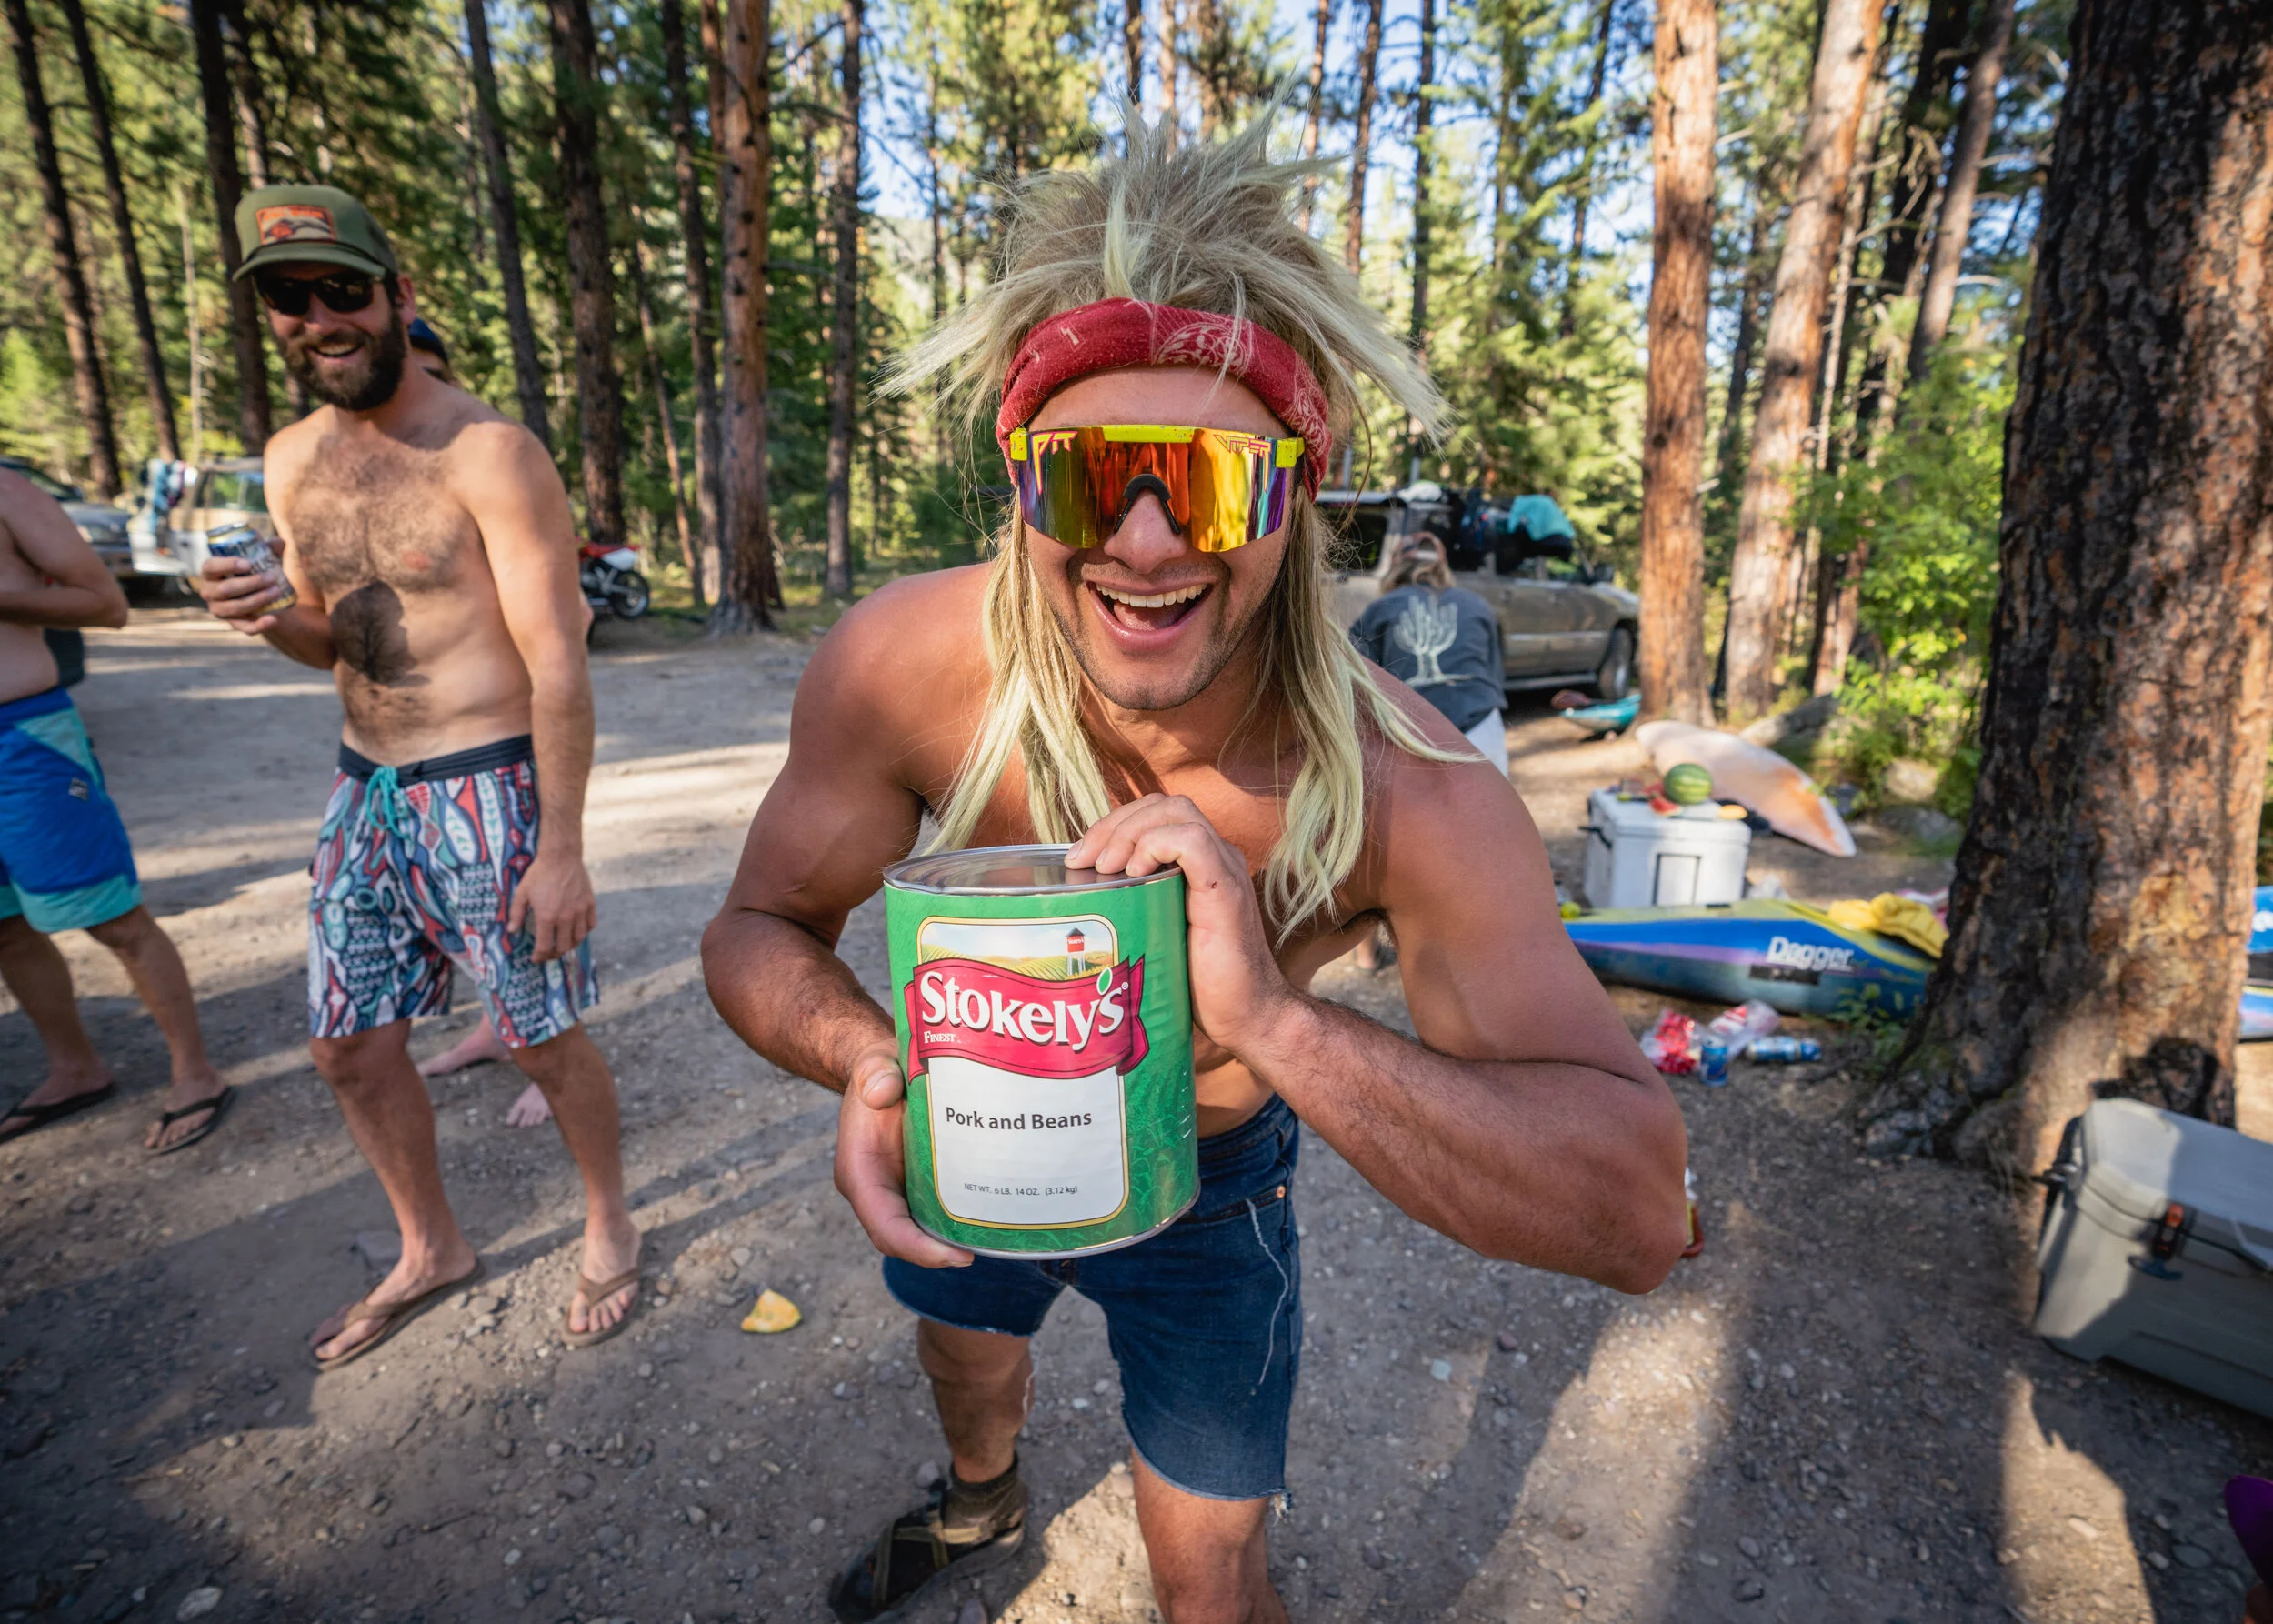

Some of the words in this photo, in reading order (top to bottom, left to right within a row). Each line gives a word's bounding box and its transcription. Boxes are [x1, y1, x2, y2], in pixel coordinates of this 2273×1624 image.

[1213, 433, 1272, 494] VIPER
[1766, 936, 1855, 972] Dagger
[946, 1107, 985, 1128] Pork
[988, 1114, 1026, 1130] and
[1031, 1112, 1093, 1130] Beans
[964, 1183, 977, 1192] NET
[994, 1187, 1000, 1195] 6
[1026, 1188, 1040, 1196] OZ.
[1045, 1187, 1064, 1197] (3.12
[1066, 1186, 1078, 1195] kg)
